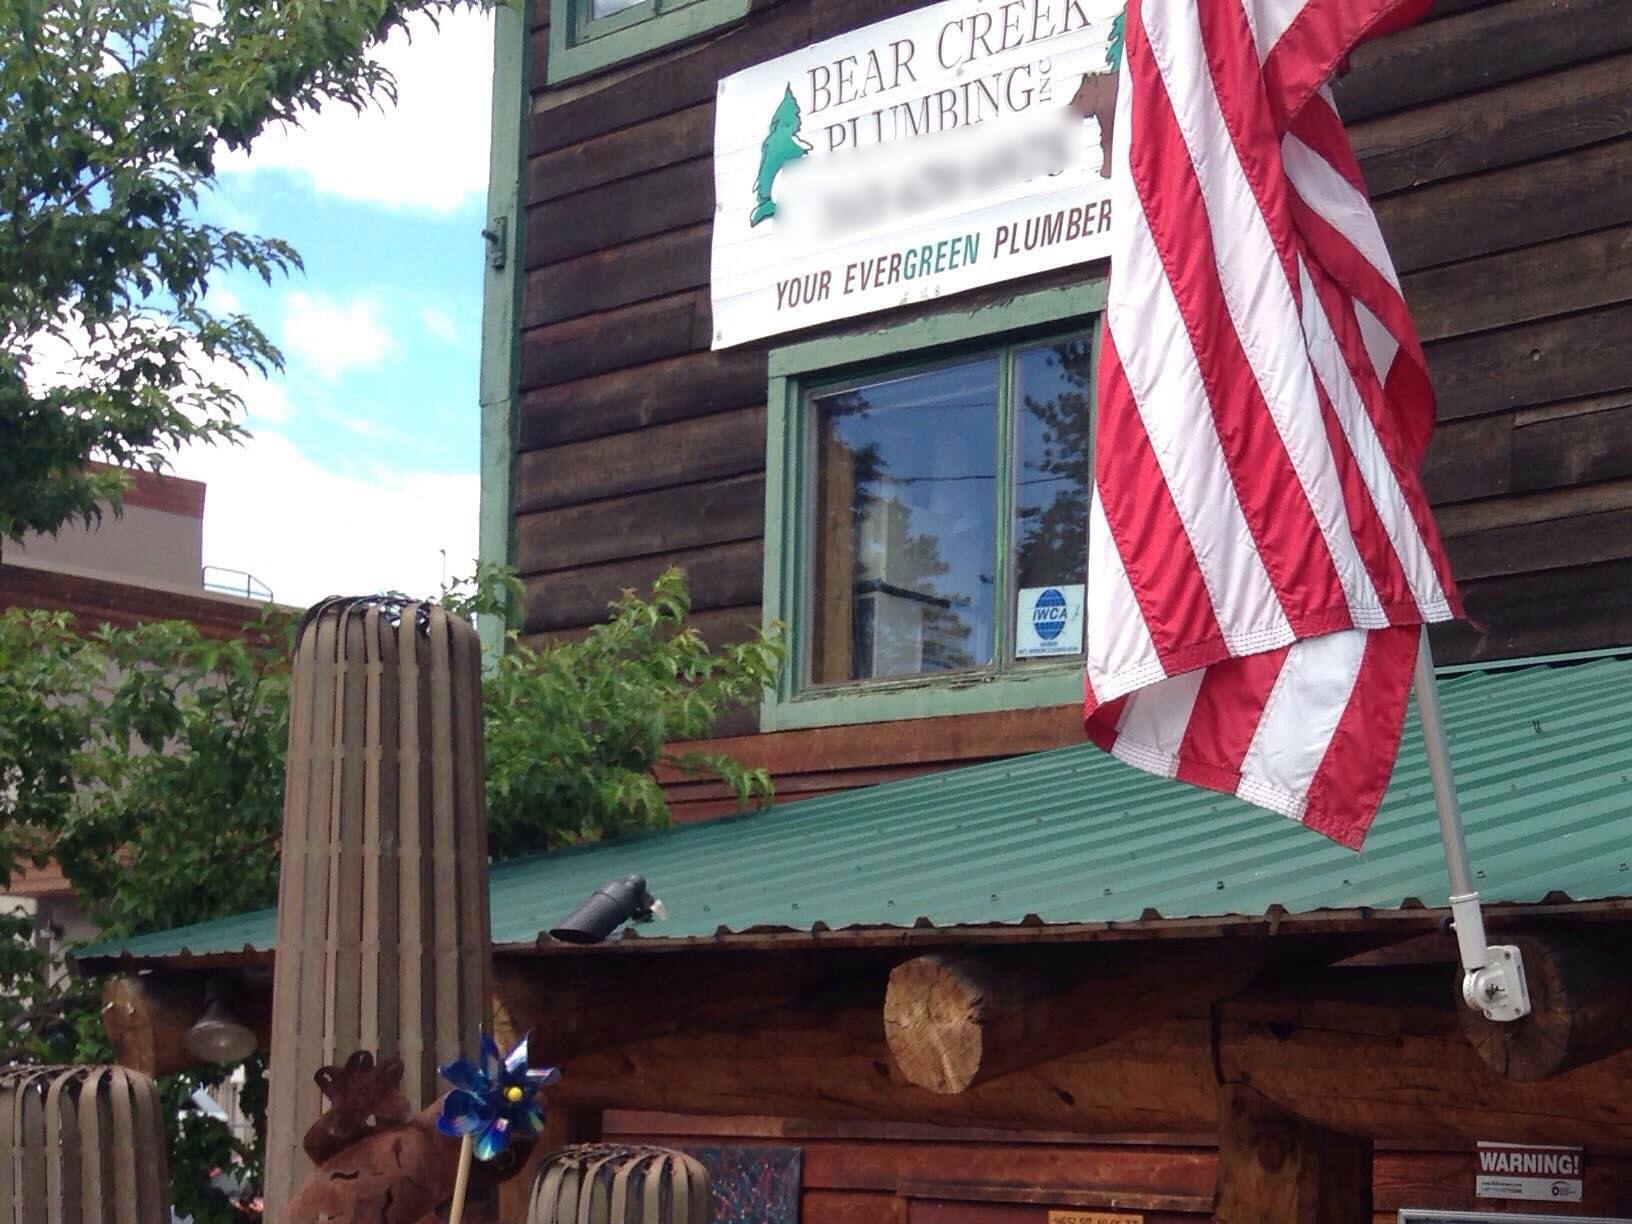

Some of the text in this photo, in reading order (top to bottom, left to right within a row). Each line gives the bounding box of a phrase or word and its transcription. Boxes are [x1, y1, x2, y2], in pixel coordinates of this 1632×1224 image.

[807, 0, 1091, 115] BEAR CREEK
[777, 270, 832, 310] YOUR
[843, 232, 980, 294] EVERGREEN
[1032, 607, 1068, 621] IWCA
[1479, 1151, 1580, 1176] WARNING!
